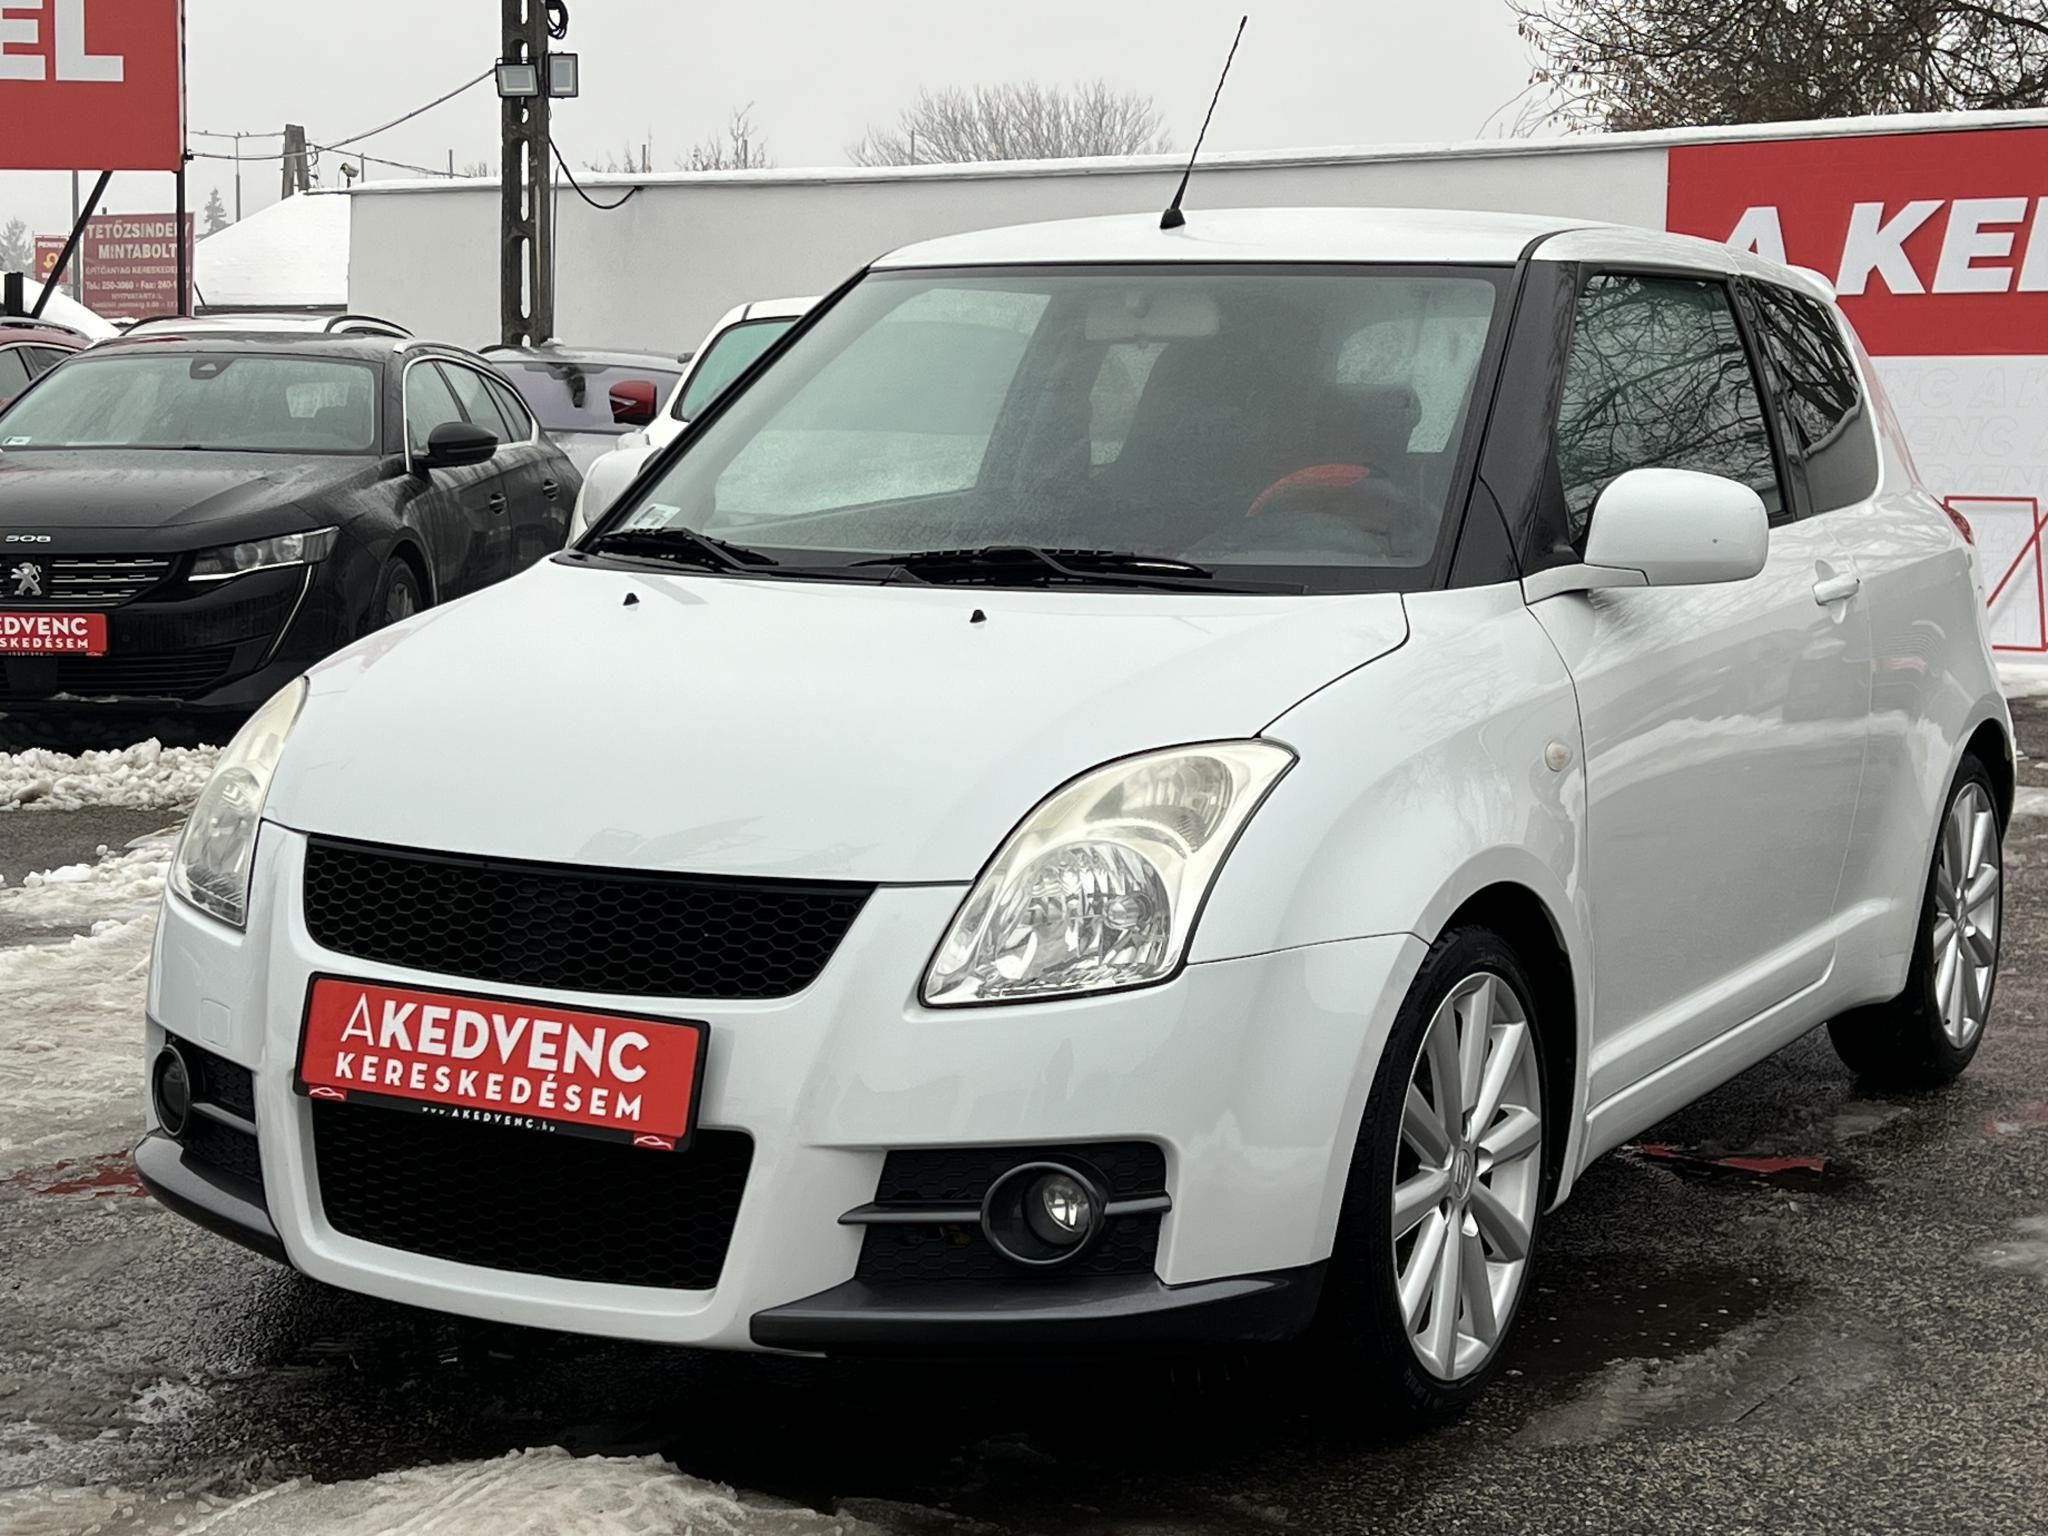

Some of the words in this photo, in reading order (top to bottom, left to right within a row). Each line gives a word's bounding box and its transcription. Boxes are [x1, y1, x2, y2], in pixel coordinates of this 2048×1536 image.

[98, 243, 177, 259] MINTABOLT
[0, 616, 88, 636] DVENC
[341, 992, 650, 1083] AKEDVENC
[335, 1051, 642, 1122] KERESKEDÉSEM
